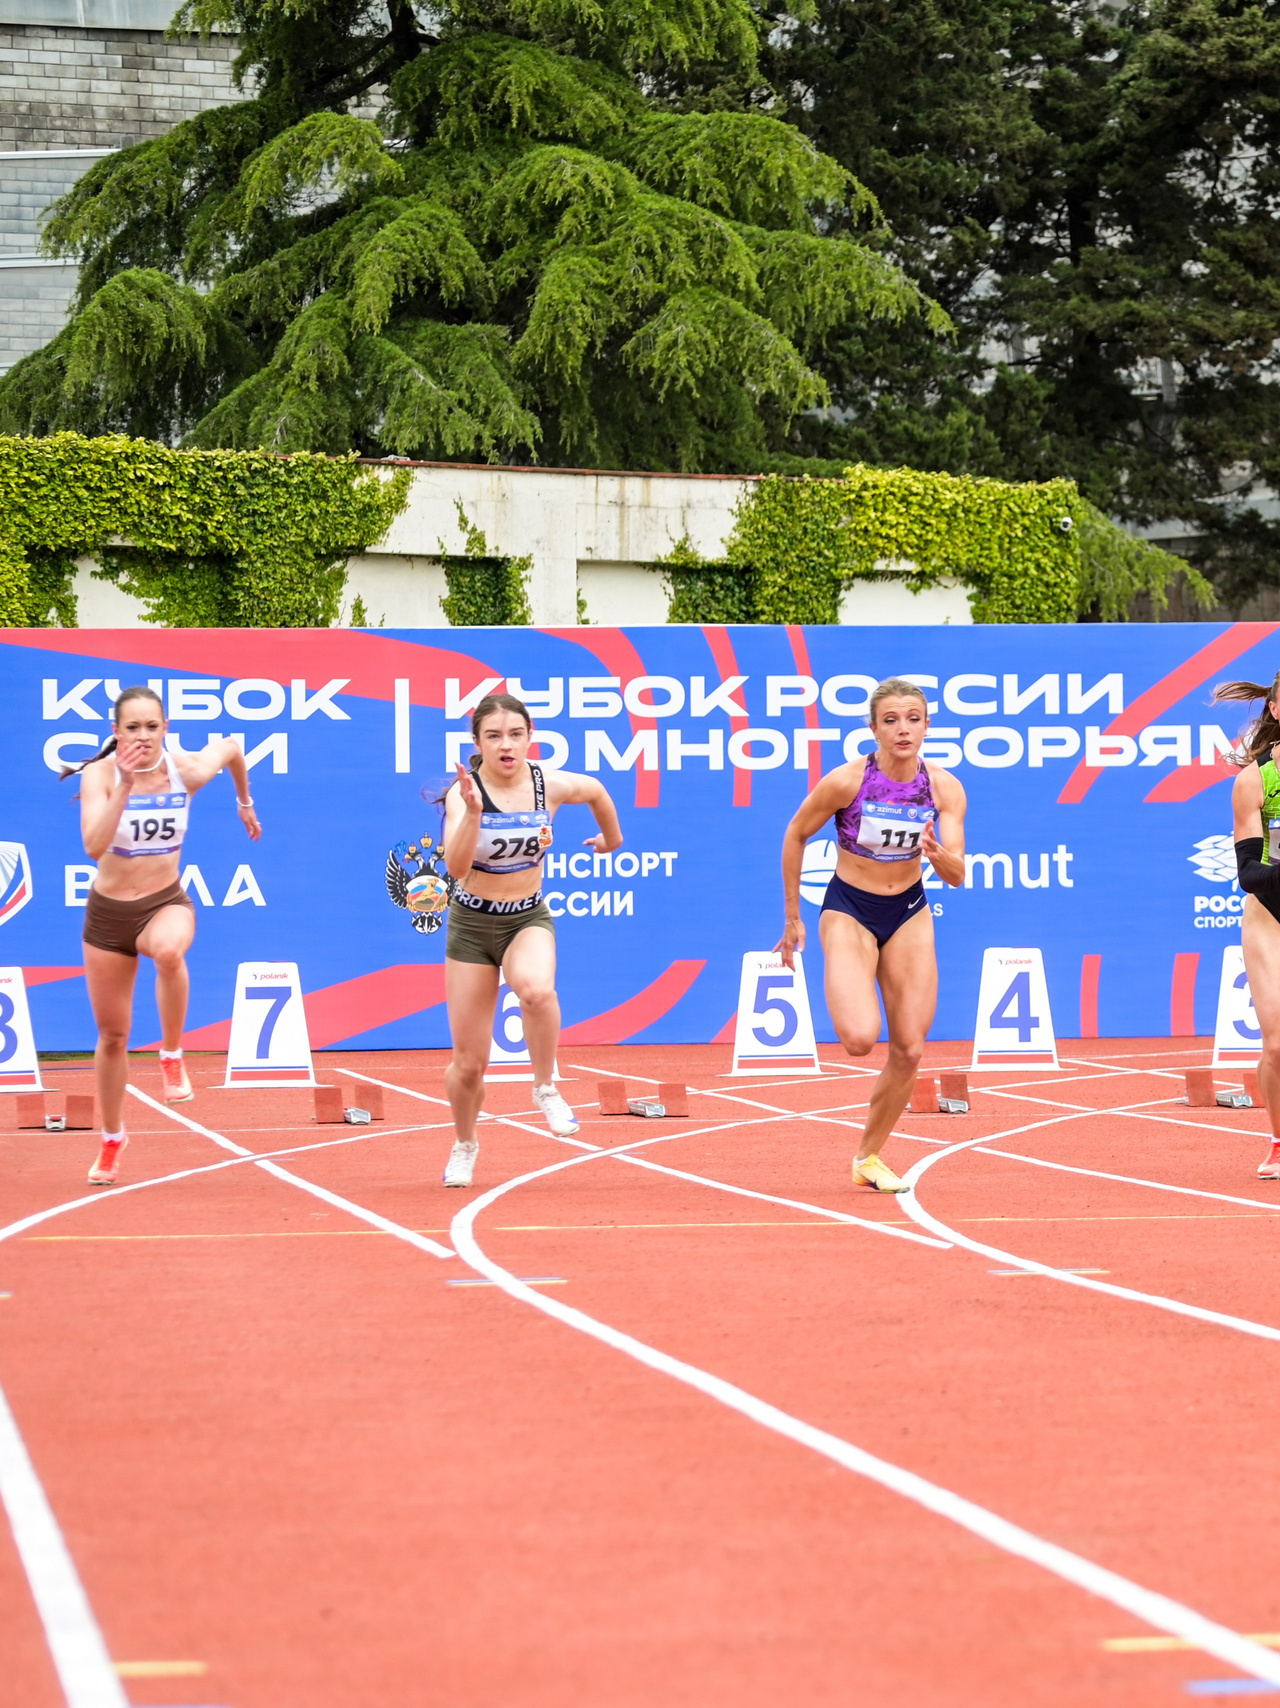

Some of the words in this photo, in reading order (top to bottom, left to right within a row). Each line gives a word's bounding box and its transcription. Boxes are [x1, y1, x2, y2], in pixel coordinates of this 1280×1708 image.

[42, 732, 289, 775] СЧИ
[877, 806, 903, 815] azimut
[130, 818, 175, 842] 195
[881, 829, 921, 849] 111
[488, 836, 540, 860] 278
[454, 886, 484, 909] PRO
[487, 894, 535, 913] NIKE
[260, 972, 289, 981] polanik
[492, 983, 529, 1053] 6
[751, 975, 798, 1047] 5
[989, 971, 1040, 1043] 4
[245, 986, 292, 1059] 7
